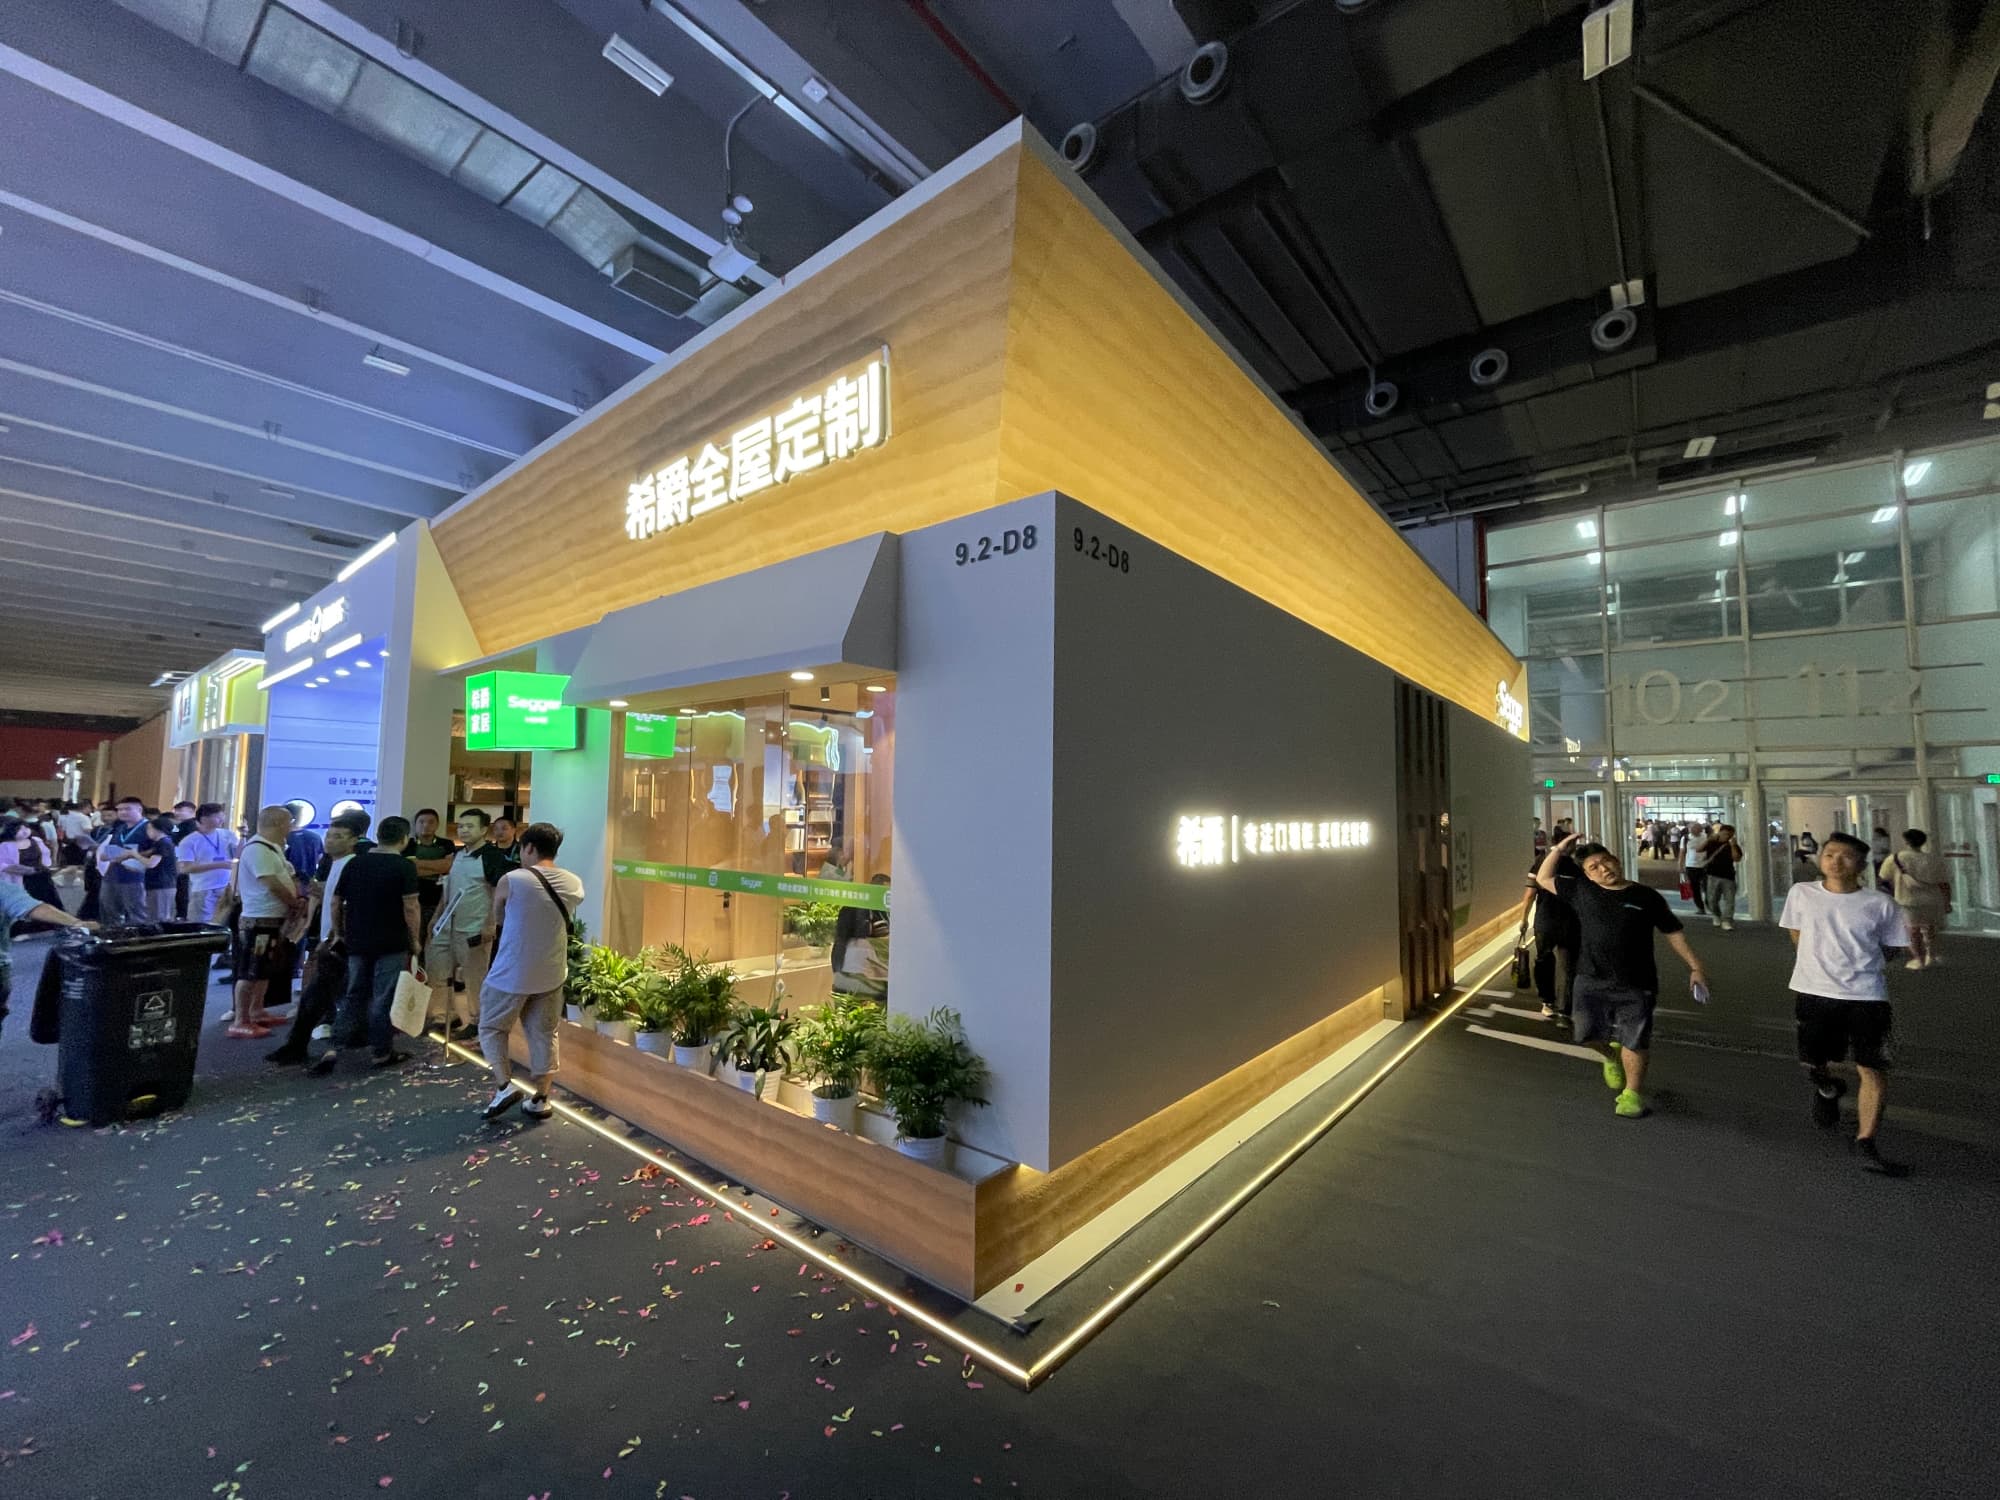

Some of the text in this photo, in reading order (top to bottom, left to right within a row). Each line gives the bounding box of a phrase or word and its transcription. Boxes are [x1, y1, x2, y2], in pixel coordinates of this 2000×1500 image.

[625, 360, 887, 540] 希爵全屋定制
[955, 525, 1038, 567] 9.2-D8
[1073, 527, 1130, 573] 9.2-D8
